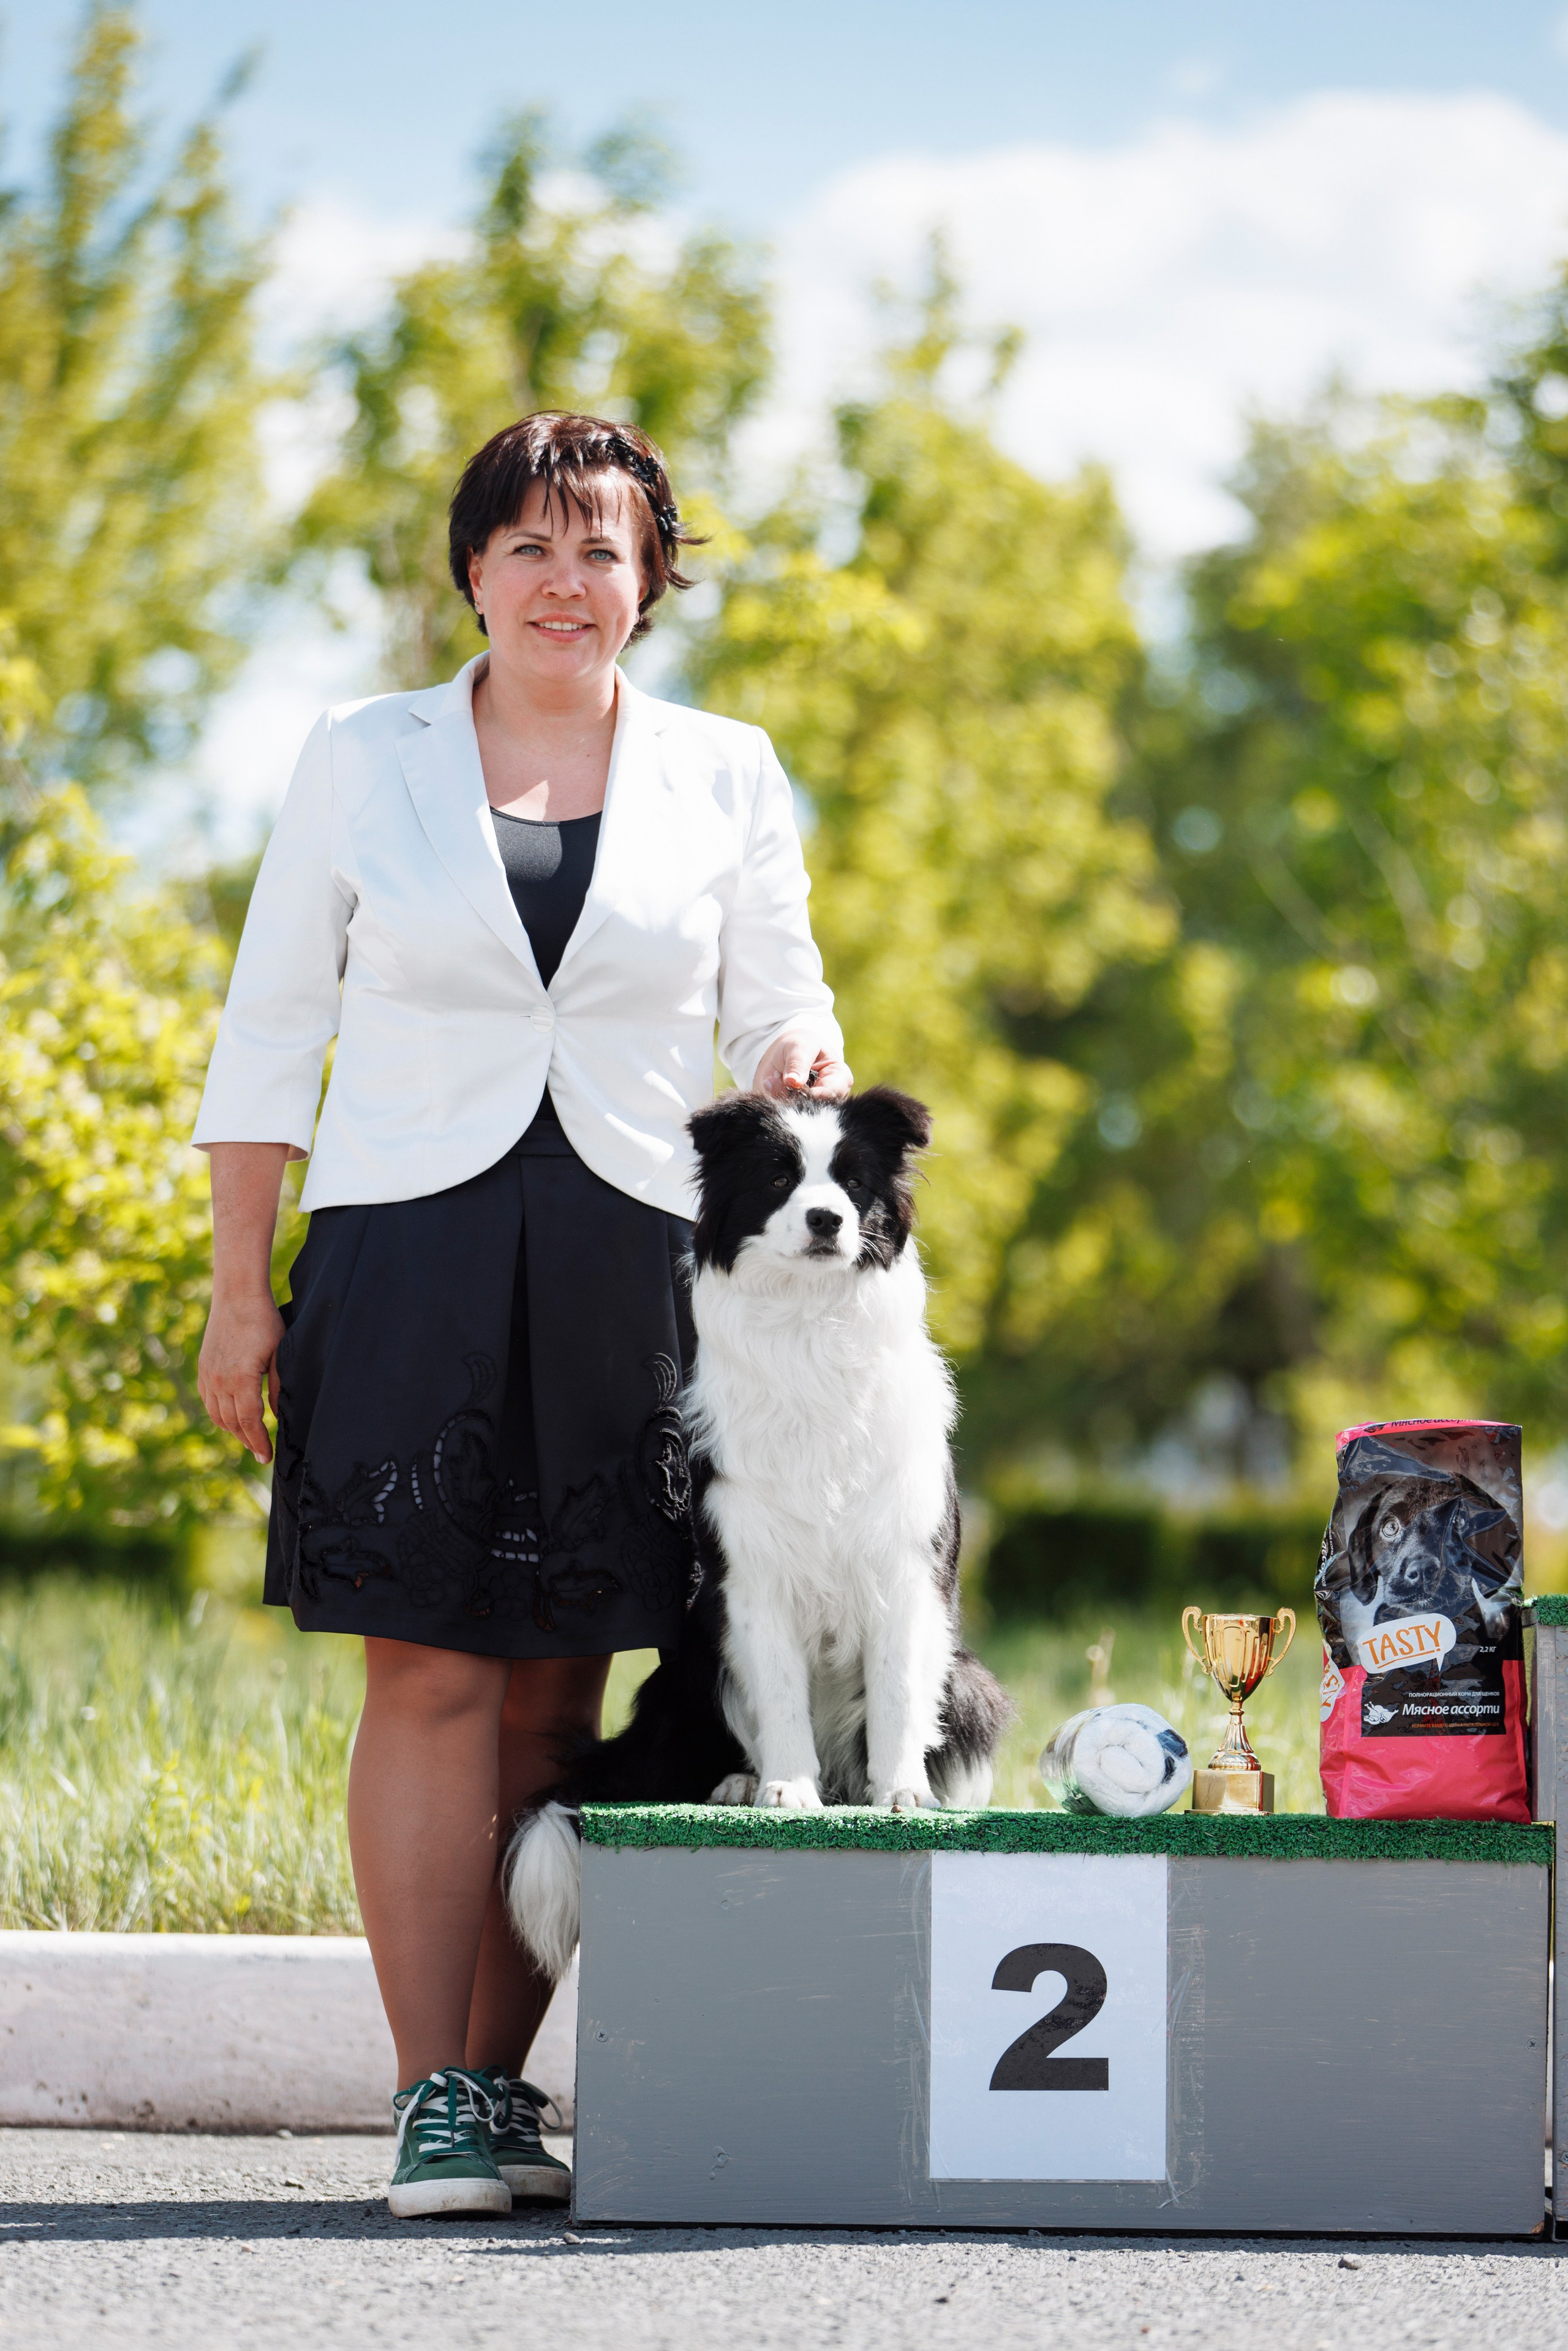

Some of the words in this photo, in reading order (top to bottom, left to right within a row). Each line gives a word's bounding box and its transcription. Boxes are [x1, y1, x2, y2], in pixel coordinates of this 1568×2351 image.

[1362, 1620, 1441, 1665] TASTY
[1402, 1703, 1450, 1716] Мясное
[1450, 1705, 1500, 1717] ассорти
[989, 1942, 1109, 2091] 2
